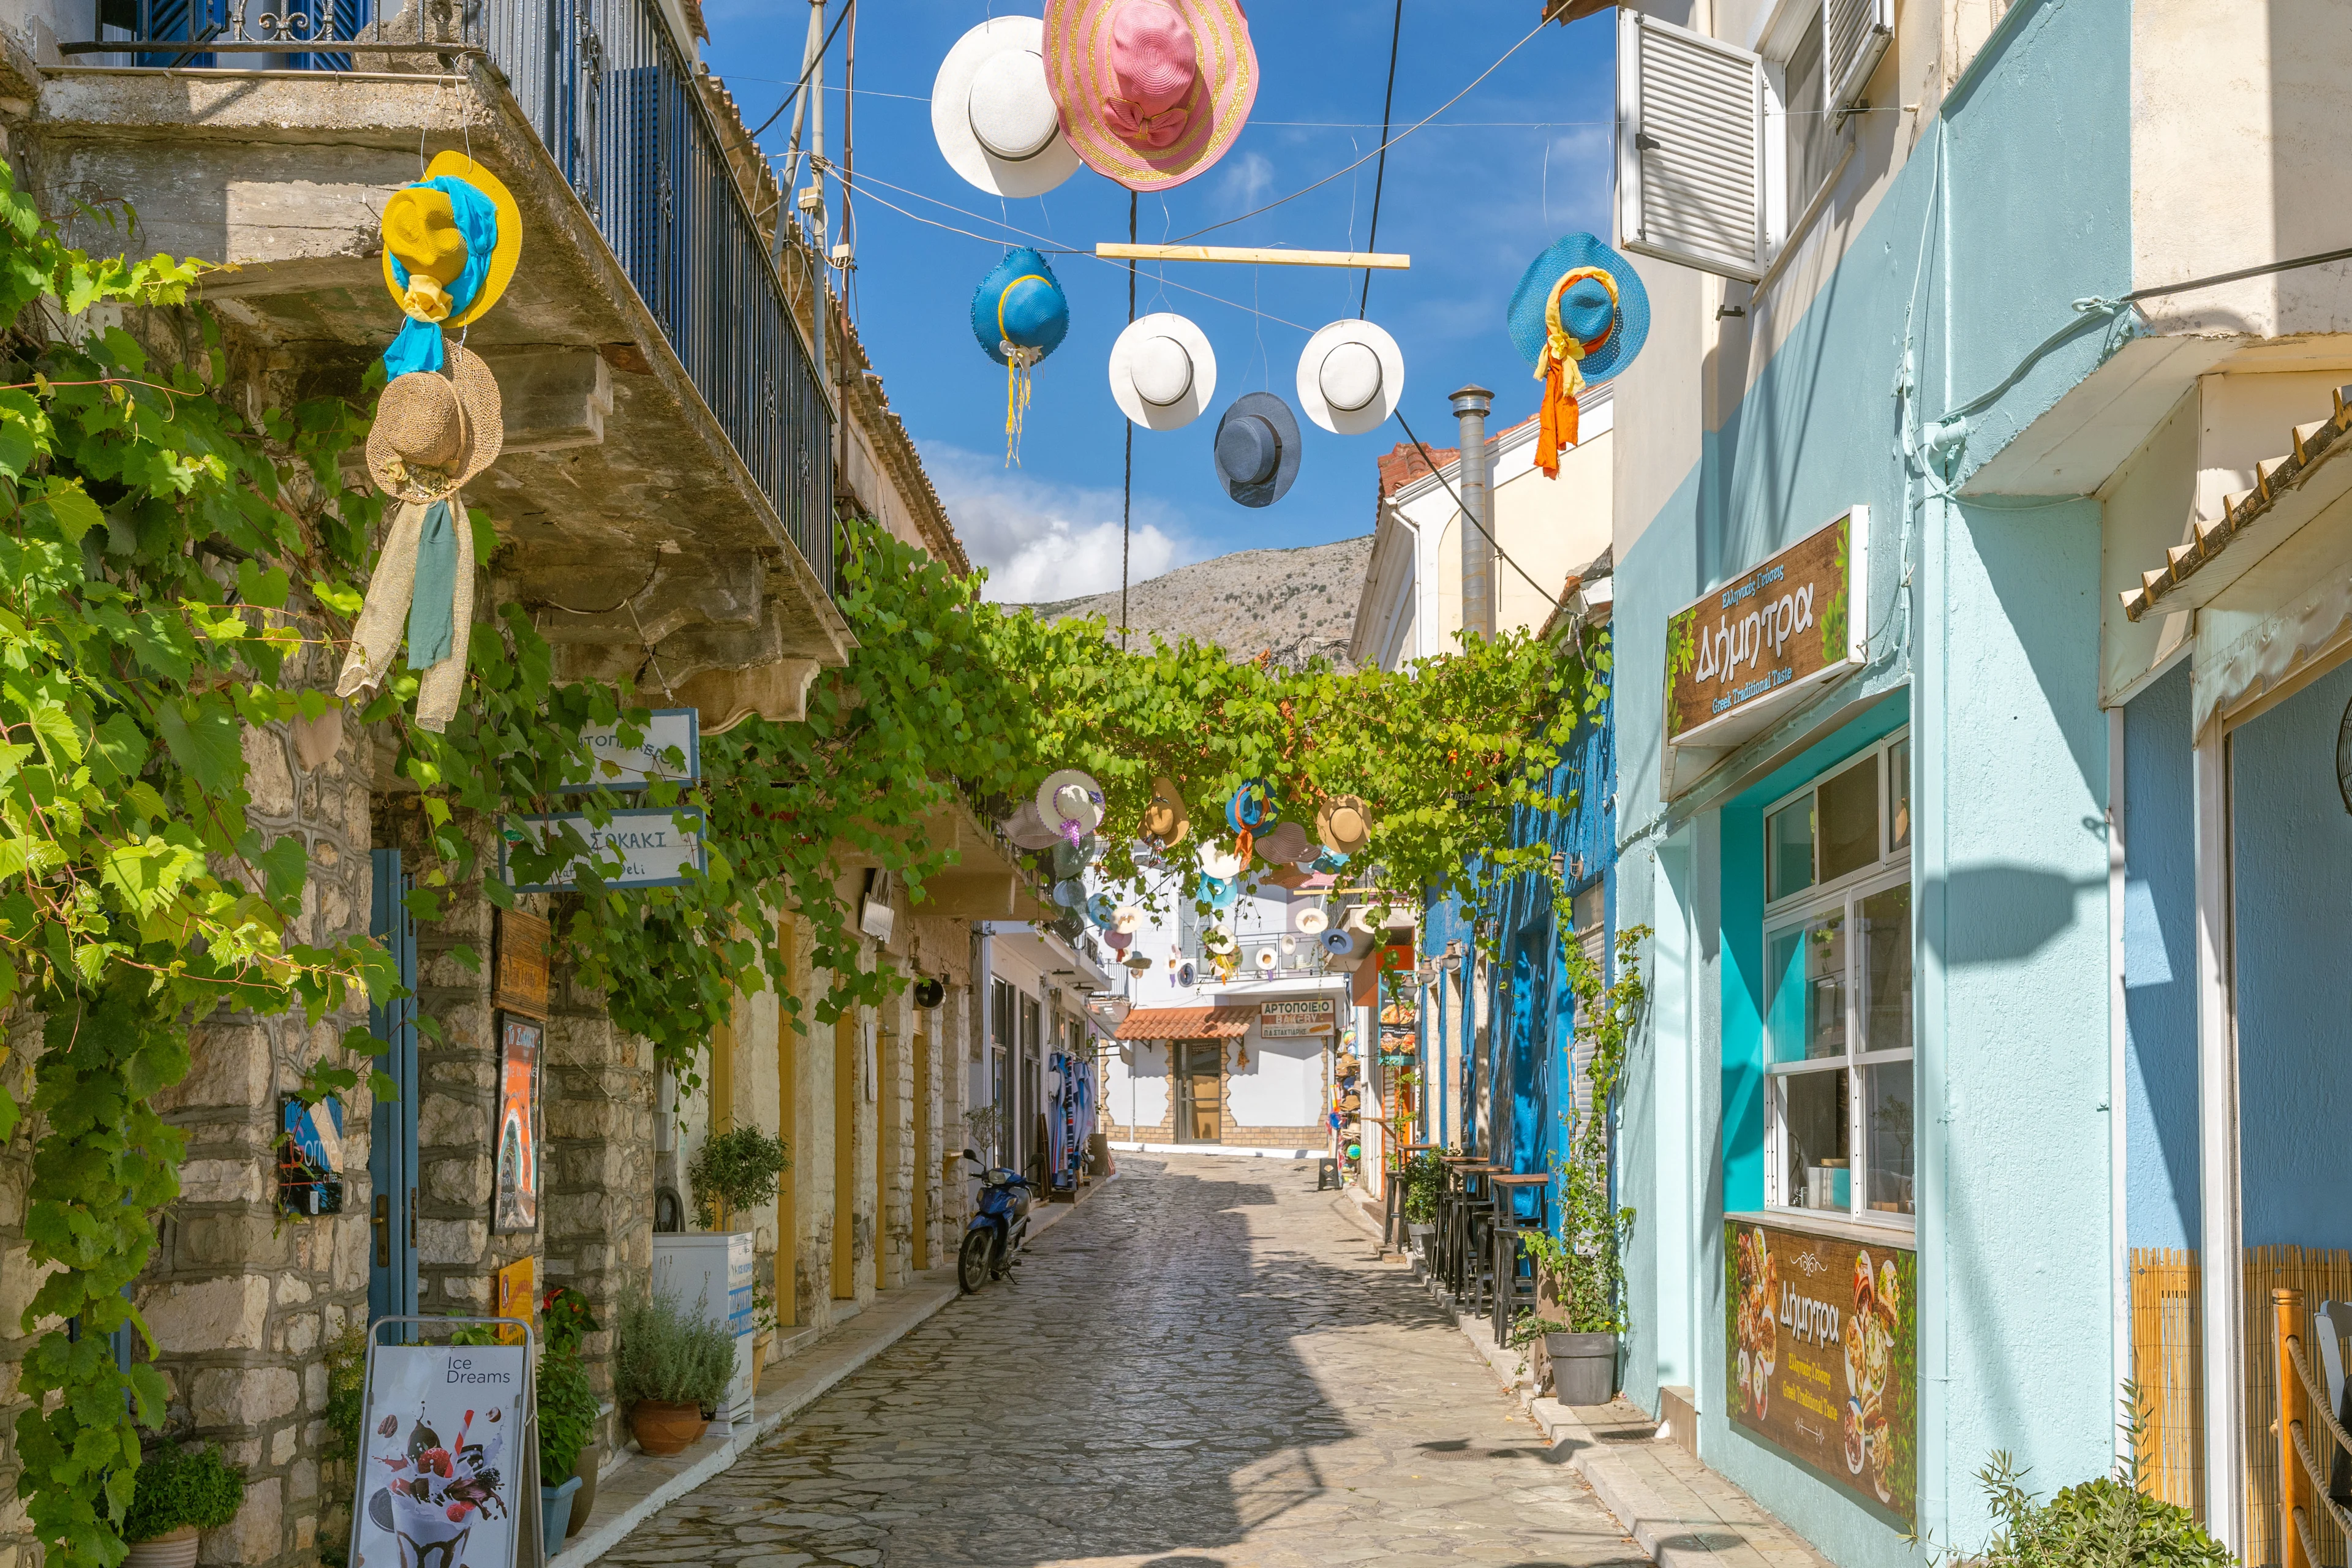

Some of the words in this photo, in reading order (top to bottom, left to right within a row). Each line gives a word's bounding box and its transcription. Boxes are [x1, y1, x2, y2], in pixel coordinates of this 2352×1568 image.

[1722, 577, 1756, 609] Ελληνικές
[1757, 564, 1784, 590] Γεύσεις
[1695, 582, 1814, 684] Δήμητρα
[1712, 693, 1732, 715] Greek
[1733, 674, 1771, 706] Traditional
[1772, 665, 1792, 687] Taste
[590, 831, 666, 851] ΣΟΚΑΚΙ
[1275, 1014, 1317, 1024] BAKERY
[323, 1167, 338, 1184] coffee
[1780, 1280, 1839, 1349] Δήμητρα
[447, 1370, 511, 1384] Dreams
[448, 1355, 472, 1370] Ice
[1782, 1380, 1796, 1403] Greek
[1796, 1386, 1823, 1416] Traditional
[1823, 1398, 1838, 1422] Taste
